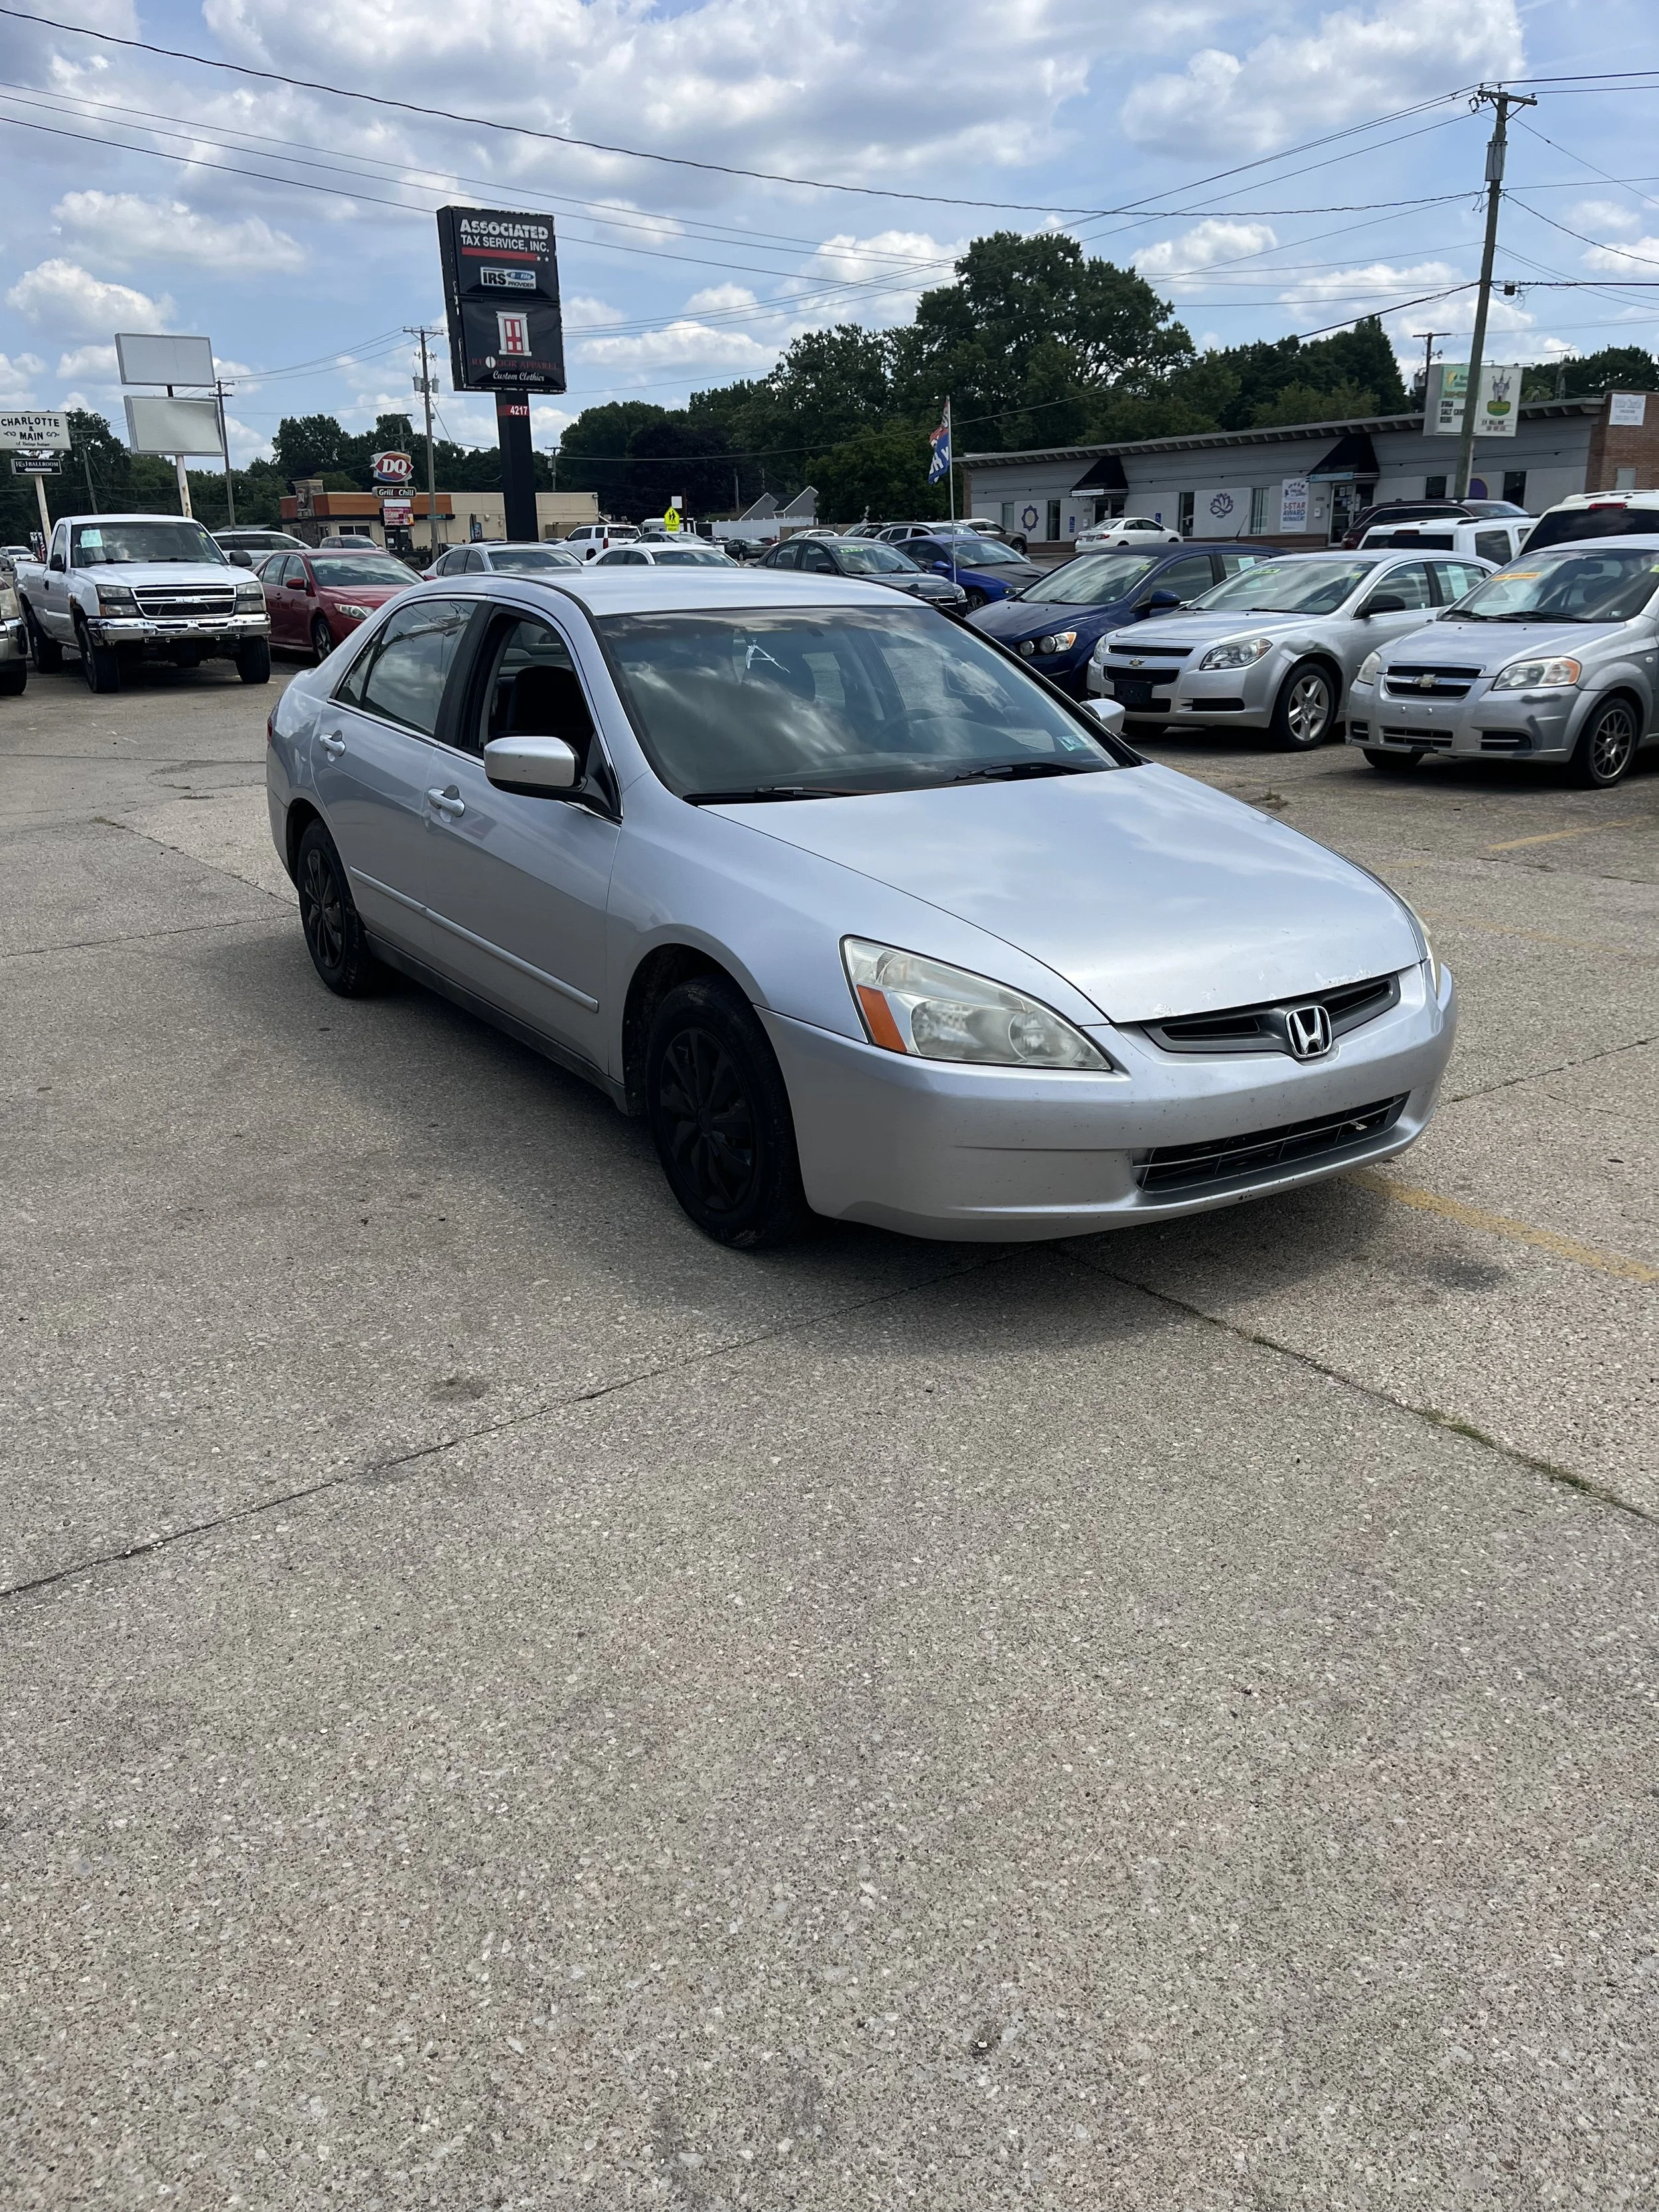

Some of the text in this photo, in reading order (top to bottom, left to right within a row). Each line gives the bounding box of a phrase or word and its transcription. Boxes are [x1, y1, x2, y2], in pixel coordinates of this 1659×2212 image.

[460, 218, 549, 240] ASSOCIATED
[461, 234, 549, 252] TAX SERVICE, INC.
[483, 271, 506, 285] IRS
[492, 370, 518, 380] Custom
[510, 406, 528, 415] 4217
[1, 417, 60, 427] CHARLOTTE
[19, 431, 44, 441] MAIN
[382, 459, 407, 475] DQ
